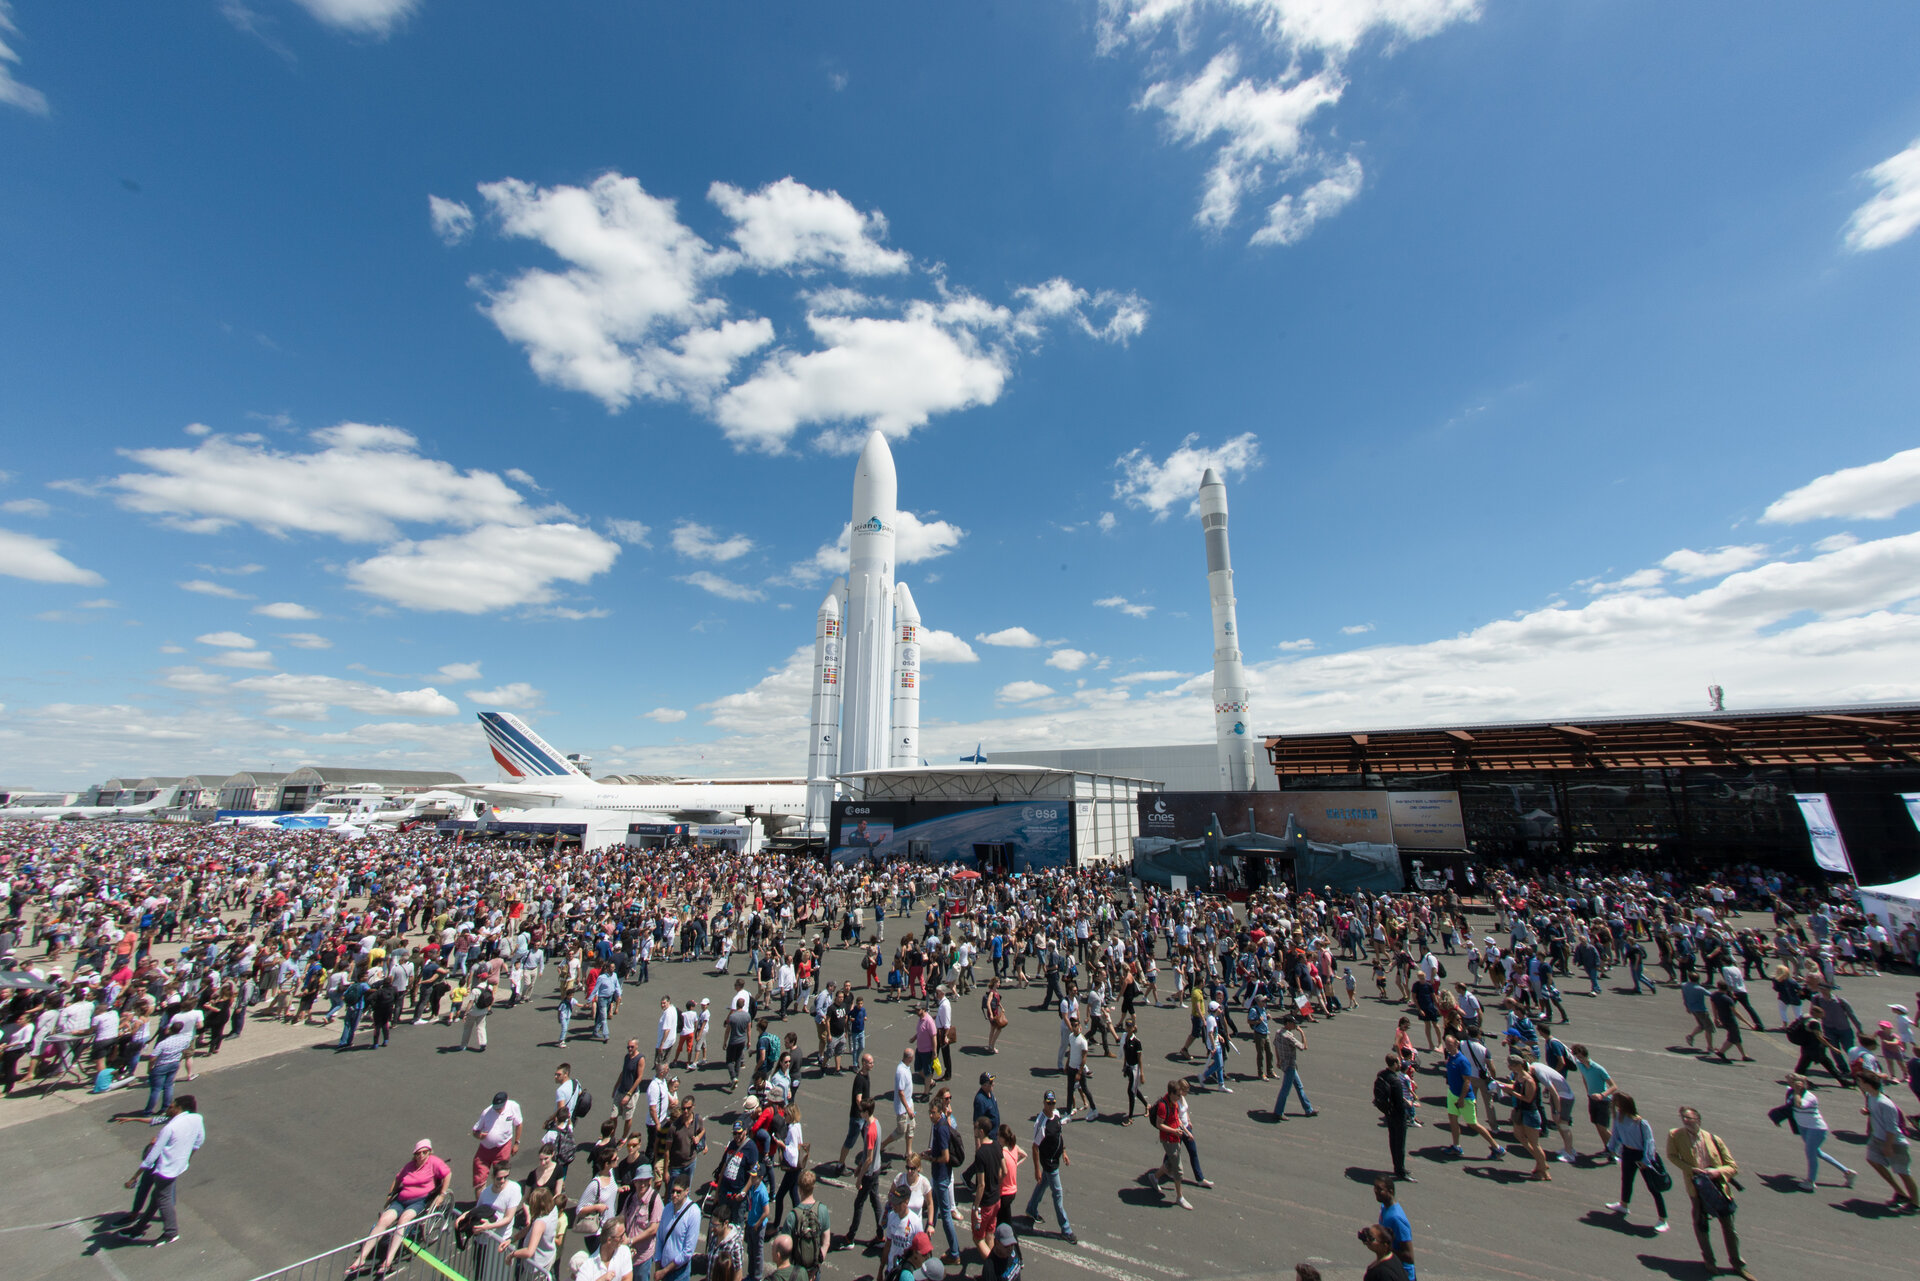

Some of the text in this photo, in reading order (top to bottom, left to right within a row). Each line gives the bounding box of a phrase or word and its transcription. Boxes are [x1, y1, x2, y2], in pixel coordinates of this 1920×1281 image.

[1036, 809, 1058, 818] esa
[1148, 814, 1175, 822] cnes
[836, 1008, 846, 1018] 501
